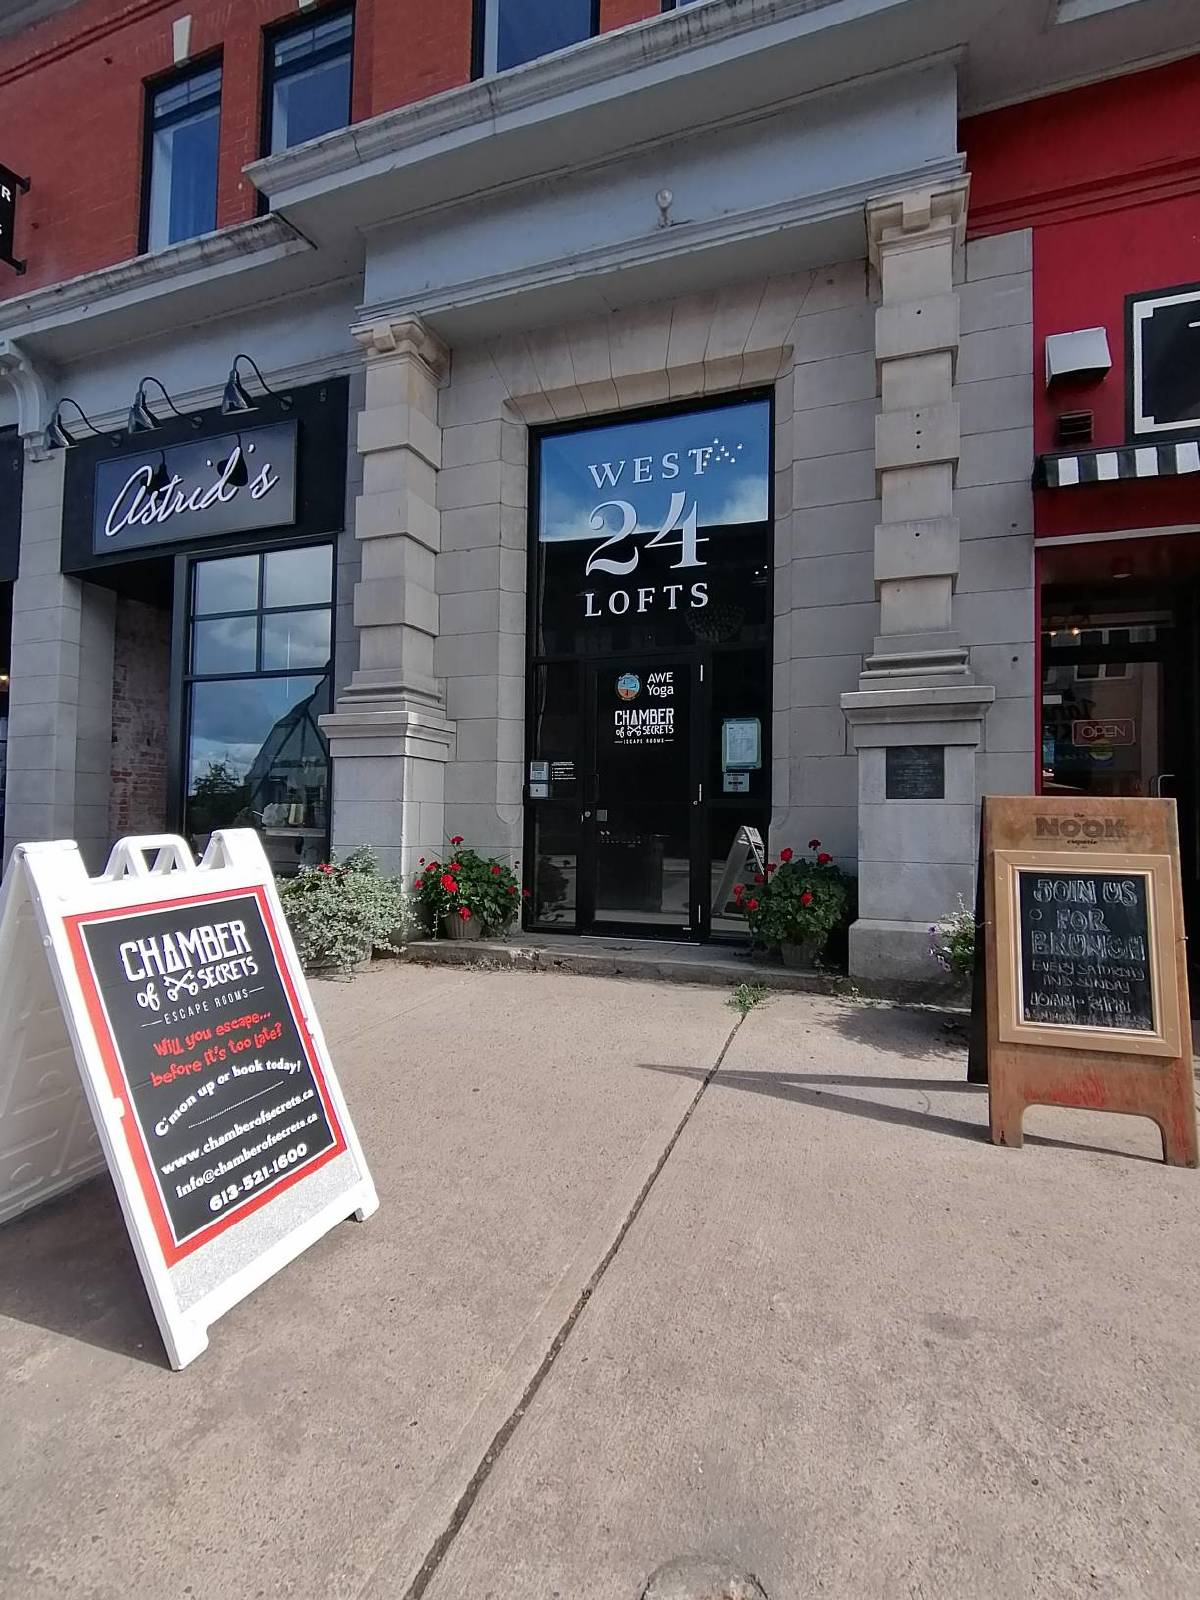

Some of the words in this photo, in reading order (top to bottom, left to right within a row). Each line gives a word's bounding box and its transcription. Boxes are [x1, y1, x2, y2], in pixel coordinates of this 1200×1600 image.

[588, 446, 713, 489] WEST
[105, 444, 279, 536] Astrid's
[585, 490, 710, 577] 24
[584, 582, 709, 617] LOFTS
[646, 683, 674, 698] Yoga
[647, 671, 674, 684] AWE
[614, 707, 674, 726] CHAMBER
[615, 726, 625, 738] of
[642, 724, 674, 735] SECRETS
[1081, 725, 1126, 738] OPEN
[1035, 816, 1127, 839] NOOK
[1033, 879, 1097, 904] JOIN
[1103, 880, 1138, 907] US
[1056, 908, 1111, 932] FOR
[119, 919, 252, 982] CHAMBER
[1031, 930, 1146, 961] BRUNCH
[136, 982, 161, 1011] of
[197, 955, 259, 990] SECRETS
[163, 1001, 209, 1025] ESCAPE
[215, 988, 249, 1008] ROOMS
[150, 1058, 203, 1088] before
[228, 1037, 252, 1054] too
[253, 1021, 283, 1049] late?
[185, 1028, 213, 1051] you
[154, 1094, 198, 1137] C'mon
[197, 1081, 216, 1098] up
[217, 1072, 231, 1086] or
[231, 1059, 265, 1078] book
[160, 1088, 315, 1176] www.chamberofsecrets.ca
[175, 1112, 319, 1199] info@chamberofsecrets.ca
[208, 1143, 308, 1212] 613-521-1600
